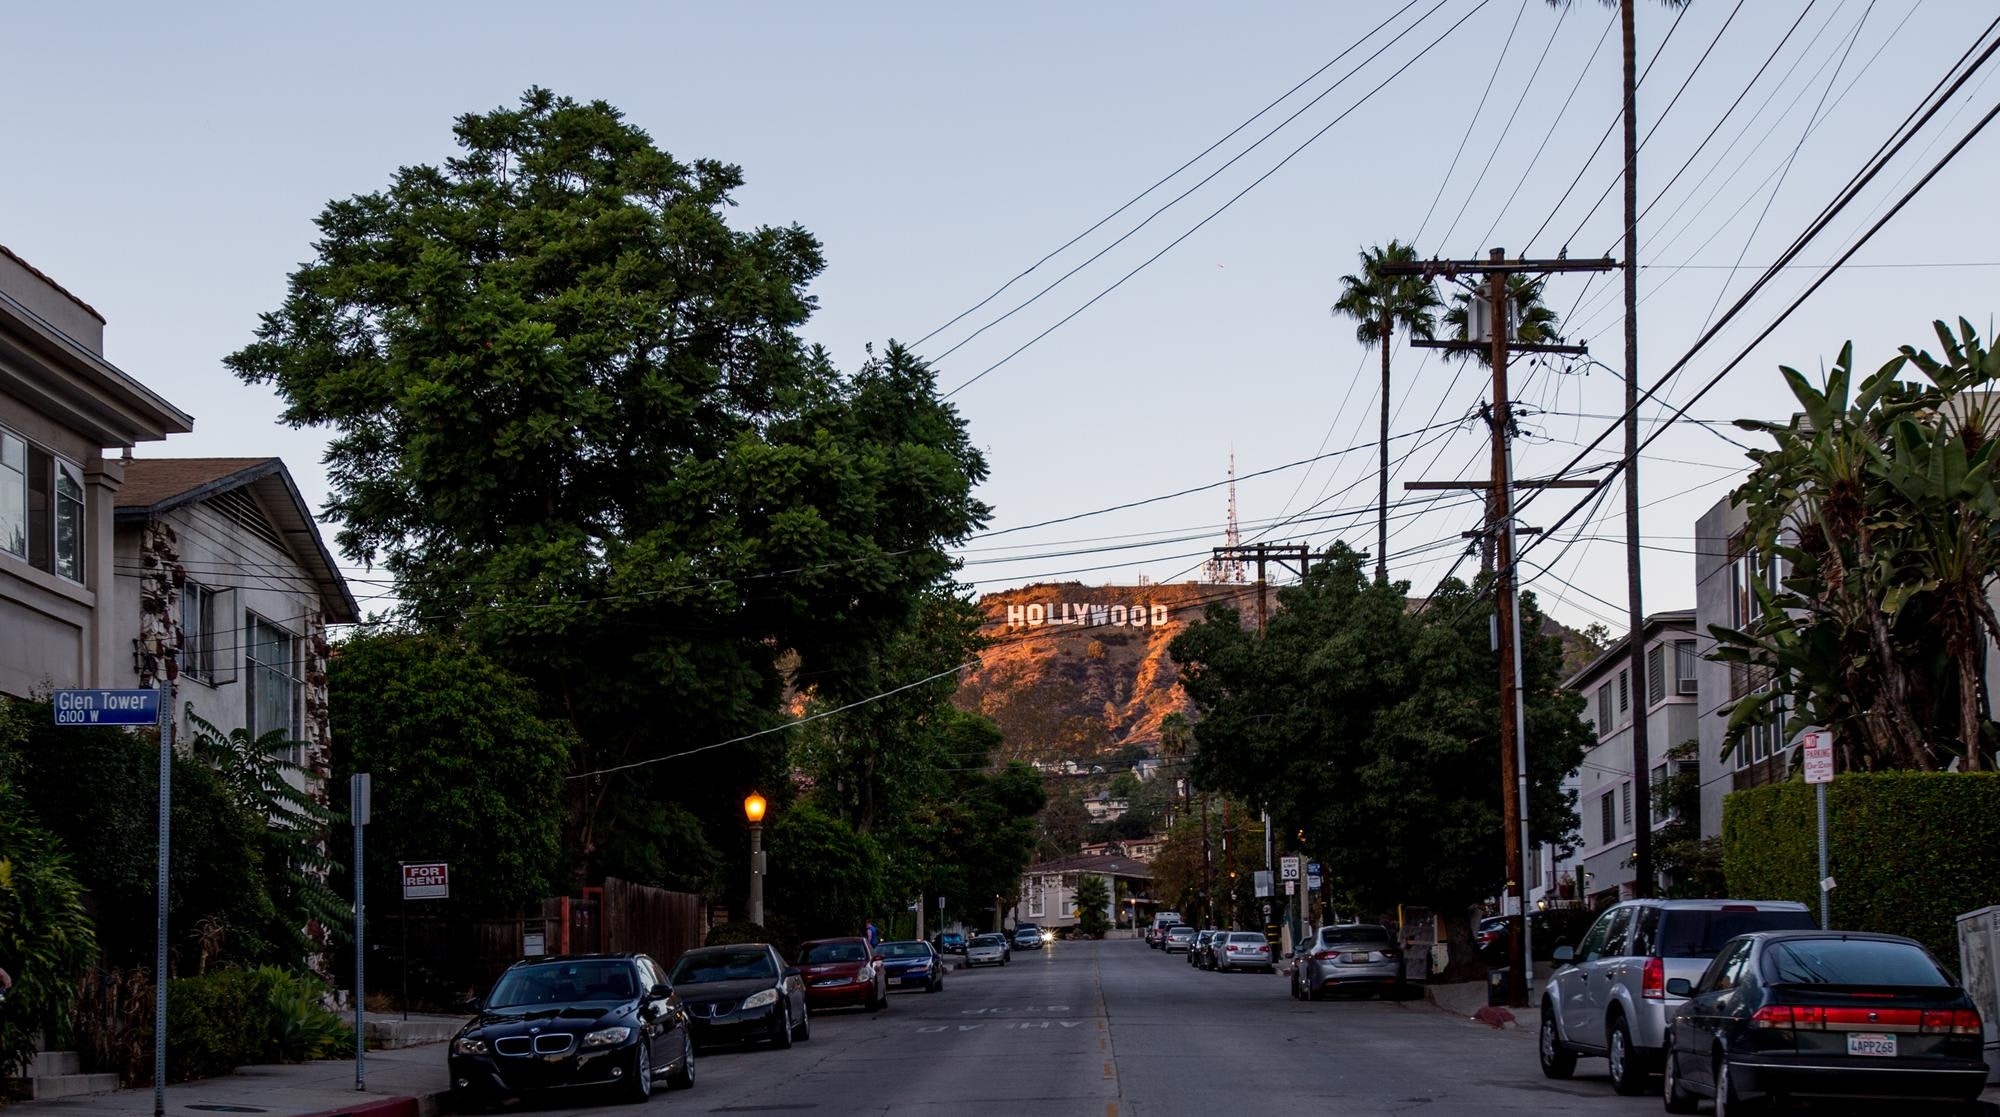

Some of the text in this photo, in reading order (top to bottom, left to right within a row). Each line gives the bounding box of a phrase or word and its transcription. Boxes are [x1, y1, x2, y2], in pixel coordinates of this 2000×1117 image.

[1007, 603, 1168, 627] HOLLYWOOD
[60, 692, 147, 710] Glen Tower
[59, 710, 99, 723] 6100 W
[1805, 735, 1816, 748] NO
[1806, 749, 1831, 759] PARKING
[411, 867, 440, 877] FOR
[1284, 869, 1297, 878] 30
[406, 876, 445, 886] RENT
[1850, 1041, 1894, 1054] 4APP268
